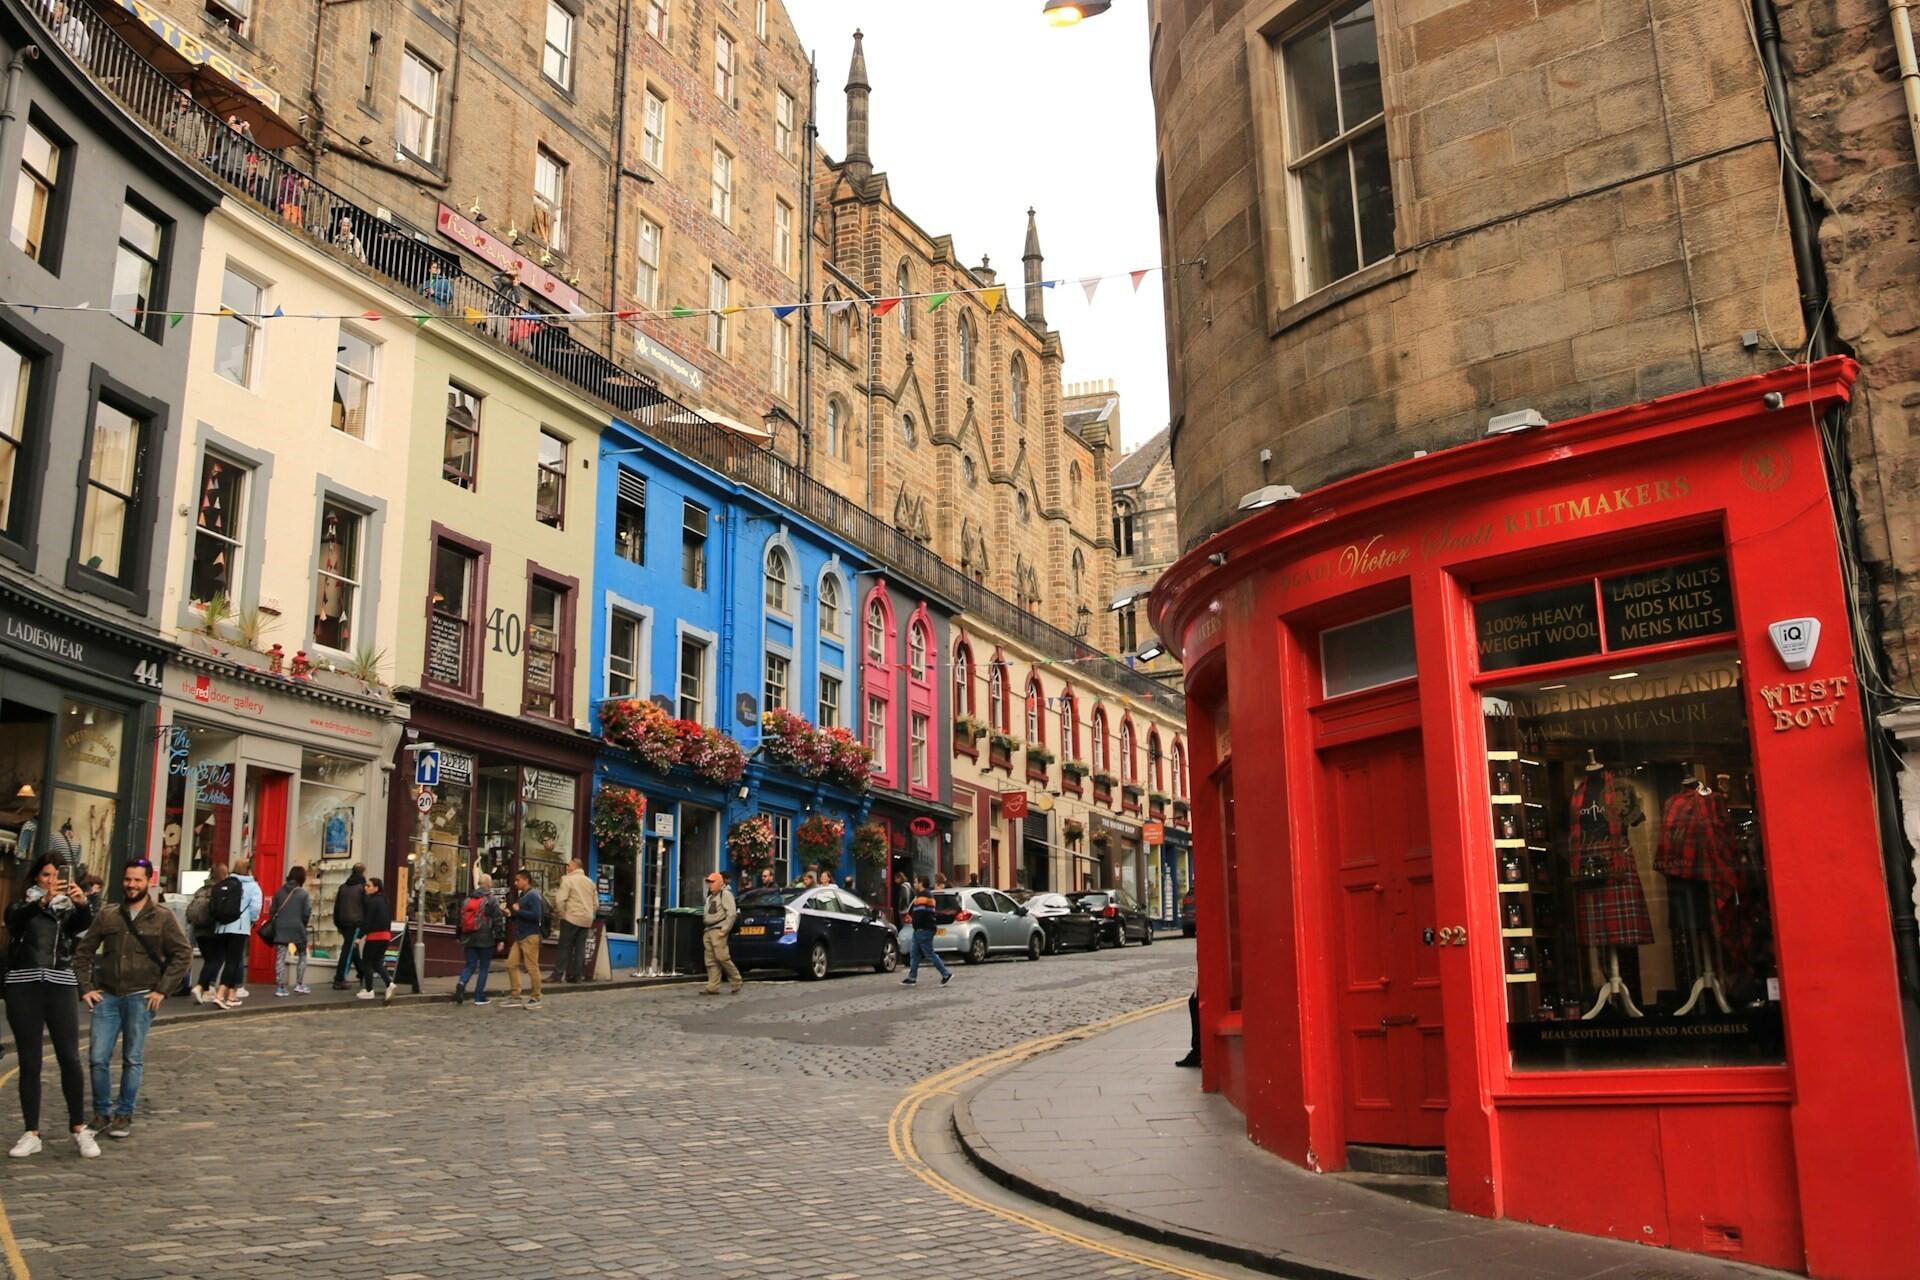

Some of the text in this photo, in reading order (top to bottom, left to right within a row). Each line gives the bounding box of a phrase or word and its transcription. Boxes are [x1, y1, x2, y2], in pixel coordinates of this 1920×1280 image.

[1338, 534, 1410, 578] Victor
[1503, 476, 1693, 536] KILTMAKERS
[1613, 567, 1721, 602] LADIES KILTS
[1485, 604, 1585, 636] 100% HEAVY
[1624, 590, 1713, 620] KIDS KILTS
[6, 617, 84, 662] LADIESWEAR
[486, 608, 521, 656] 40
[1478, 621, 1598, 656] WEIGHT WOOL
[1620, 609, 1723, 641] MENS KILTS
[1783, 626, 1801, 641] iQ
[182, 680, 264, 714] the red door gallery
[1493, 668, 1734, 722] MADE IN SCOTLAND
[1761, 676, 1848, 710] WEST
[1583, 716, 1609, 737] TO
[1613, 703, 1713, 731] MEASURE
[1772, 701, 1839, 731] BOW
[419, 797, 431, 808] 20
[1439, 925, 1467, 947] 92
[1540, 1023, 1749, 1041] REAL SCOTTISH KILTS AND ACCESORIES
